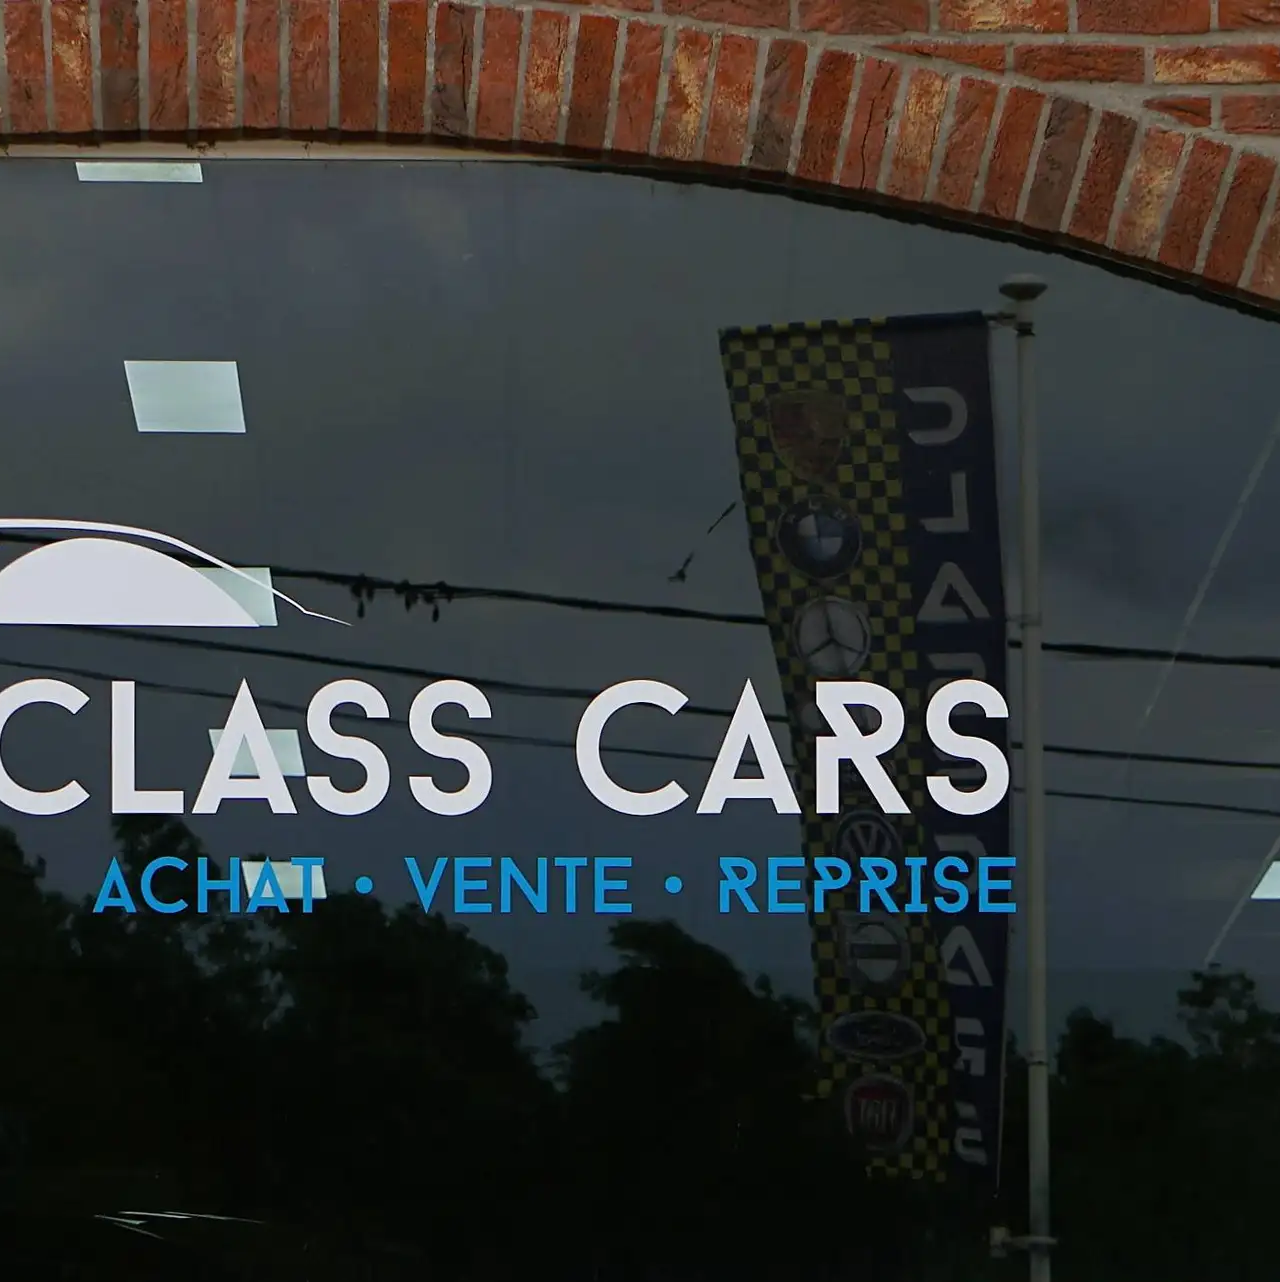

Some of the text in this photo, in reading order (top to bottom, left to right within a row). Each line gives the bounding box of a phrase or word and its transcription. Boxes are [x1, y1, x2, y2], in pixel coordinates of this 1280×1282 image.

[576, 678, 1009, 816] CARS
[94, 856, 1017, 914] ACHAT VENTE REPRISE
